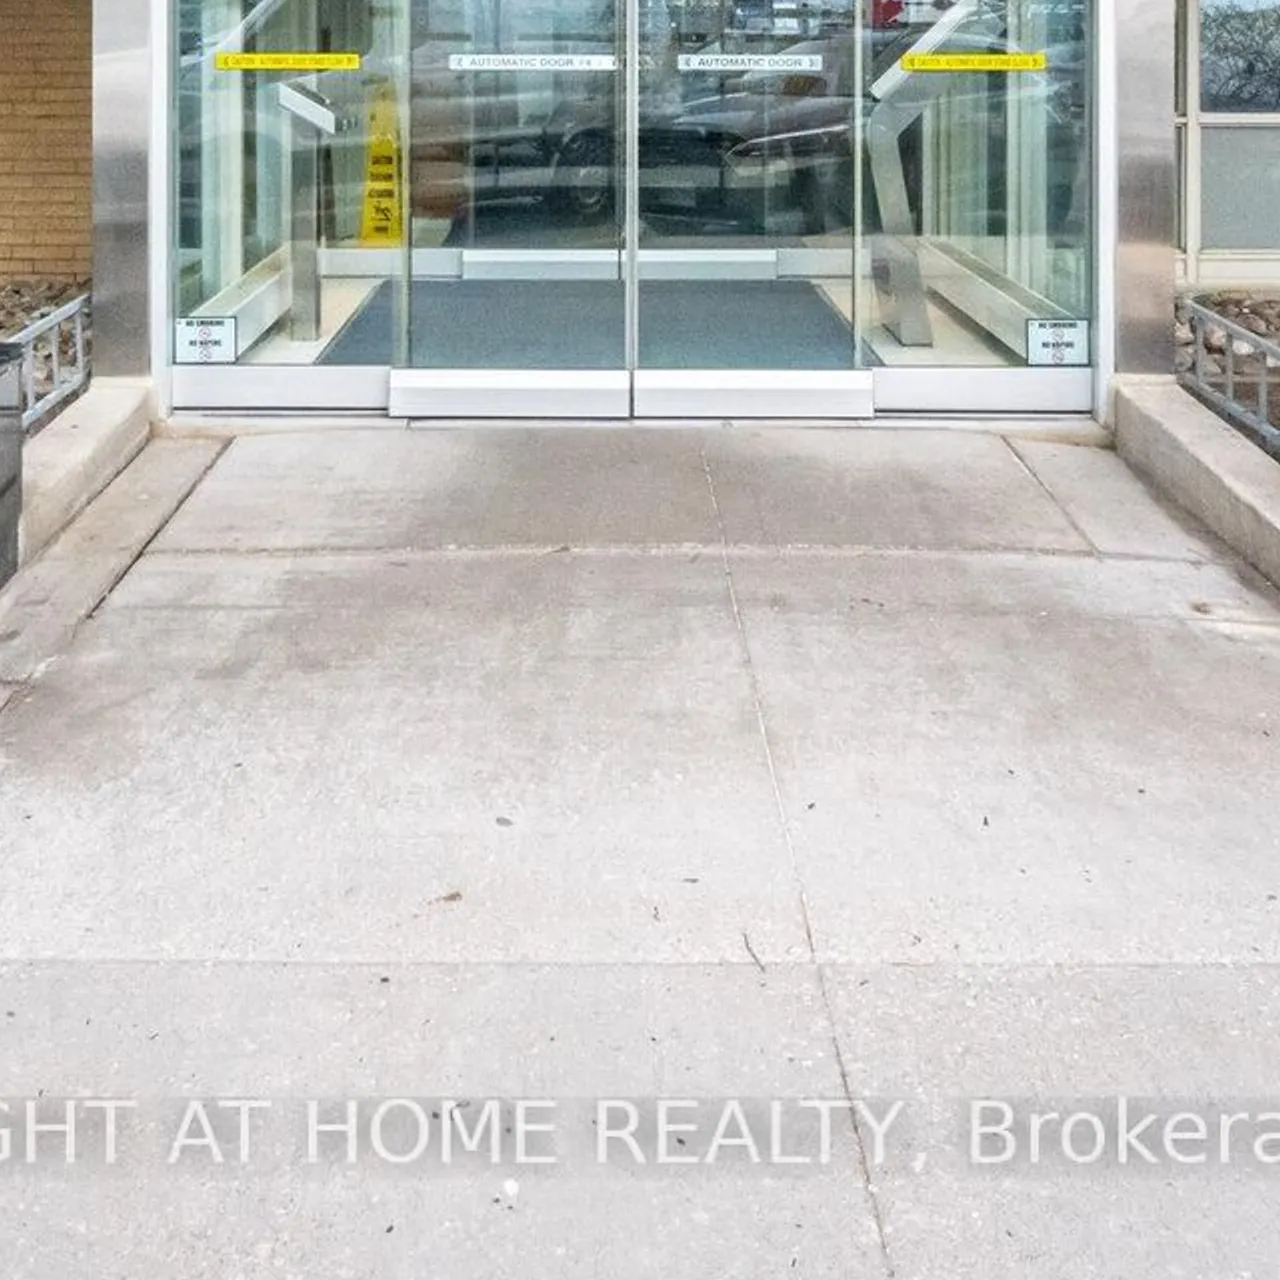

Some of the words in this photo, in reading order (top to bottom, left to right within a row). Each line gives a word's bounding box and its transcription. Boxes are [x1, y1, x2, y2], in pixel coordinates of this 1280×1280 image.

[470, 57, 538, 67] AUTOMATIC
[540, 57, 573, 67] DOOR
[698, 57, 765, 67] AUTOMATIC
[767, 57, 803, 67] DOOR
